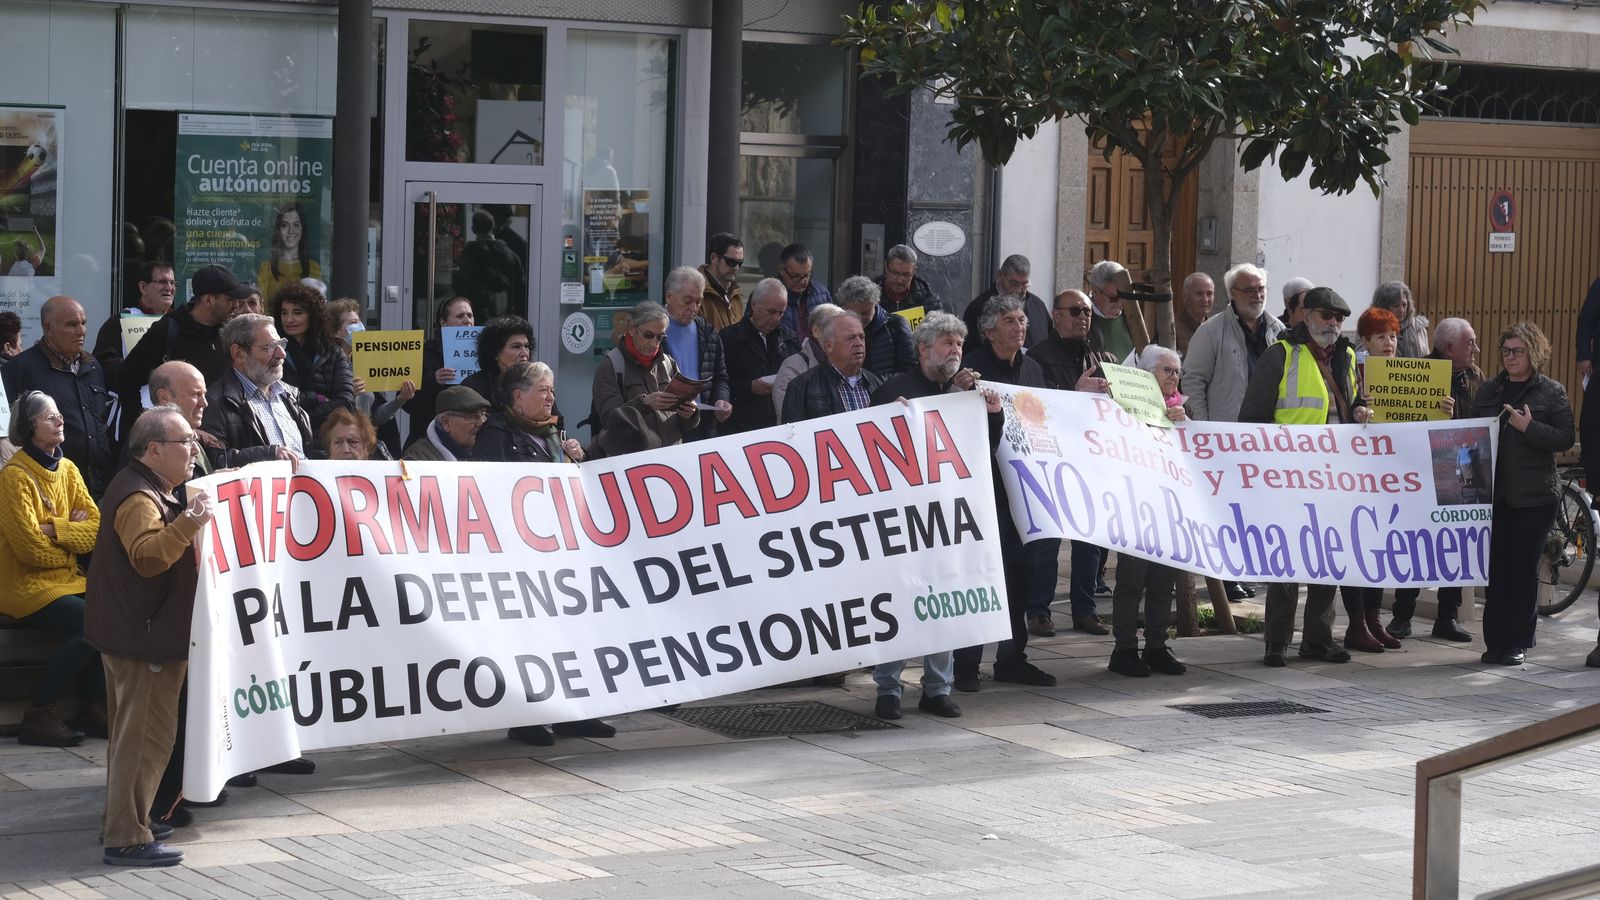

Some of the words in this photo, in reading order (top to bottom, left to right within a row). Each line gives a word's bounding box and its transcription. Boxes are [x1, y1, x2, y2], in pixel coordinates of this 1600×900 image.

[187, 154, 258, 175] Cuenta
[264, 155, 323, 177] online
[198, 174, 312, 193] autónomos
[186, 208, 210, 216] Hazte
[186, 217, 212, 226] online
[213, 219, 219, 228] y
[220, 217, 249, 226] disfruta
[251, 218, 262, 226] de
[186, 230, 204, 238] una
[206, 229, 237, 238] cuenta
[186, 240, 208, 250] para
[209, 239, 261, 248] autónomos
[18, 299, 29, 309] gol
[355, 340, 422, 352] PENSIONES
[453, 349, 461, 358] A
[1385, 359, 1431, 370] NINGUNA
[368, 366, 411, 378] DIGNAS
[1388, 373, 1430, 383] PENSIÓN
[1118, 379, 1150, 390] PENSIONES
[1369, 385, 1389, 394] POR
[1391, 386, 1427, 396] DEBAJO
[1429, 388, 1447, 397] DEL
[1374, 398, 1413, 408] UMBRAL
[1415, 400, 1428, 409] DE
[1430, 401, 1441, 410] LA
[1385, 412, 1428, 422] POBREZA
[1176, 427, 1340, 460] Igualdad
[1350, 433, 1396, 456] en
[1083, 429, 1193, 487] Salarios
[1202, 470, 1225, 497] y
[1237, 463, 1423, 494] Pensiones
[510, 409, 972, 554] CIUDADANA
[1008, 458, 1097, 538] NO
[1102, 490, 1128, 549] a
[1123, 474, 1164, 560] la
[1158, 485, 1297, 580] Brecha
[1299, 503, 1347, 582] de
[1430, 506, 1493, 523] CÓRDOBA
[299, 576, 380, 634] LA
[394, 564, 631, 627] DEFENSA
[633, 542, 752, 604] DEL
[757, 496, 985, 580] SISTEMA
[913, 584, 1002, 622] CÓRDOBA
[514, 651, 591, 705] DE
[593, 591, 899, 694] PENSIONES
